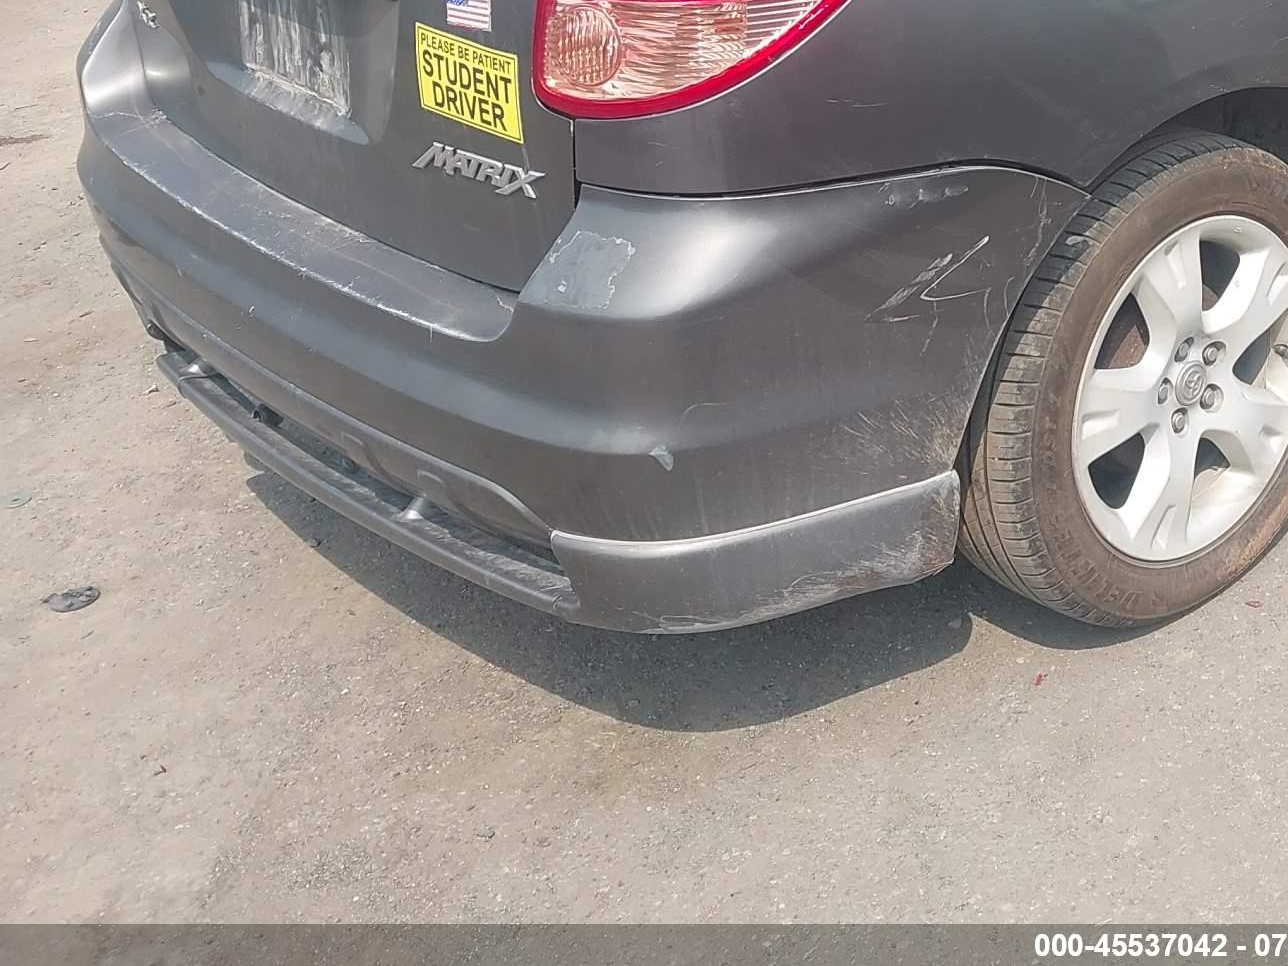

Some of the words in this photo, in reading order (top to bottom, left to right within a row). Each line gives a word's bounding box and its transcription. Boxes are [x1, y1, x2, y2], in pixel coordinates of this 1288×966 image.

[420, 32, 456, 57] PLEASE
[457, 47, 470, 62] BE
[472, 52, 511, 75] PATIENT
[422, 49, 512, 105] STUDENT
[432, 80, 508, 132] DRIVER
[411, 141, 547, 200] MATRIX
